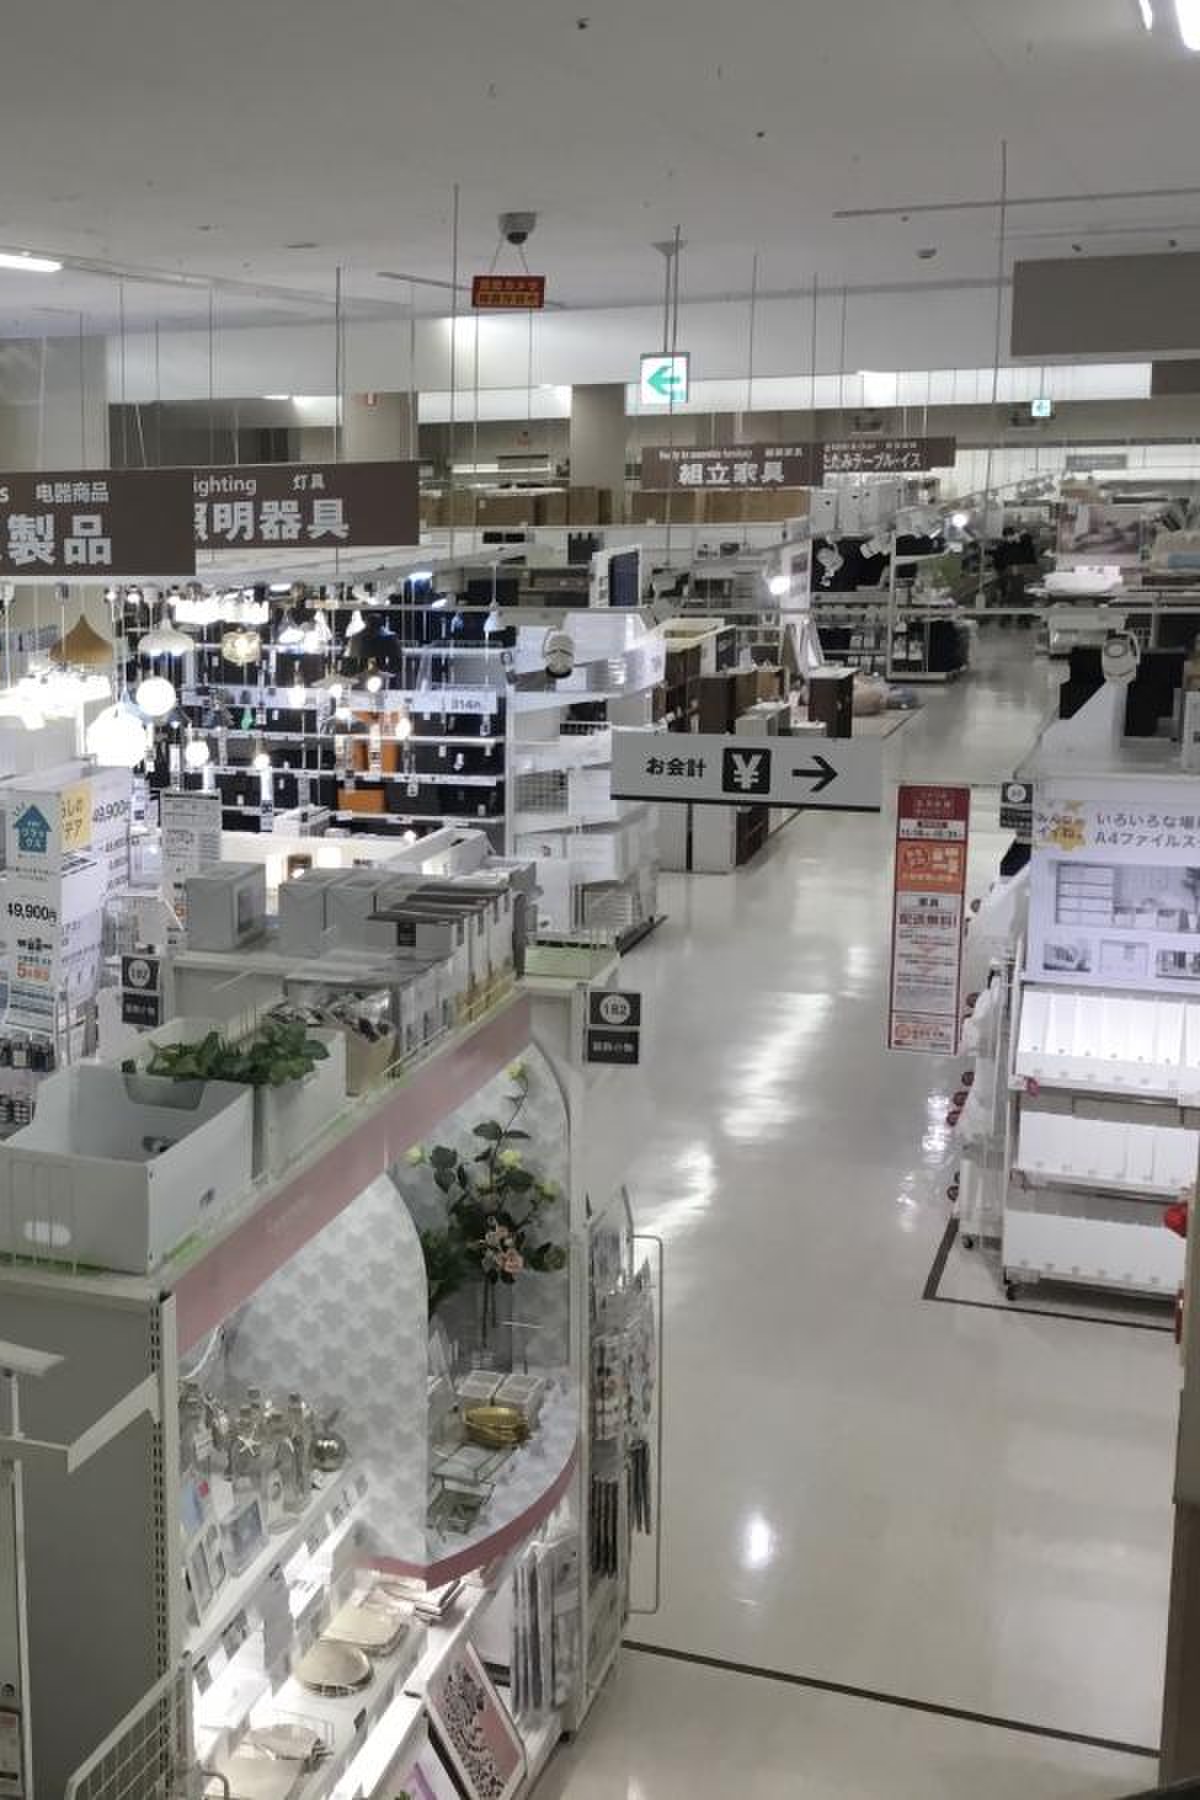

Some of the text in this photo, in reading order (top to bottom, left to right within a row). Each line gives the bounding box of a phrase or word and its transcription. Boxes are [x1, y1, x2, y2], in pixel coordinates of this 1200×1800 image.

[293, 473, 325, 491] 灯具
[677, 461, 785, 486] 組立家具
[35, 481, 109, 503] 电器商品
[193, 475, 257, 497] ighting
[646, 757, 707, 778] お会計
[1097, 813, 1200, 830] いろいろな場
[1096, 831, 1200, 848] A4ファイルス
